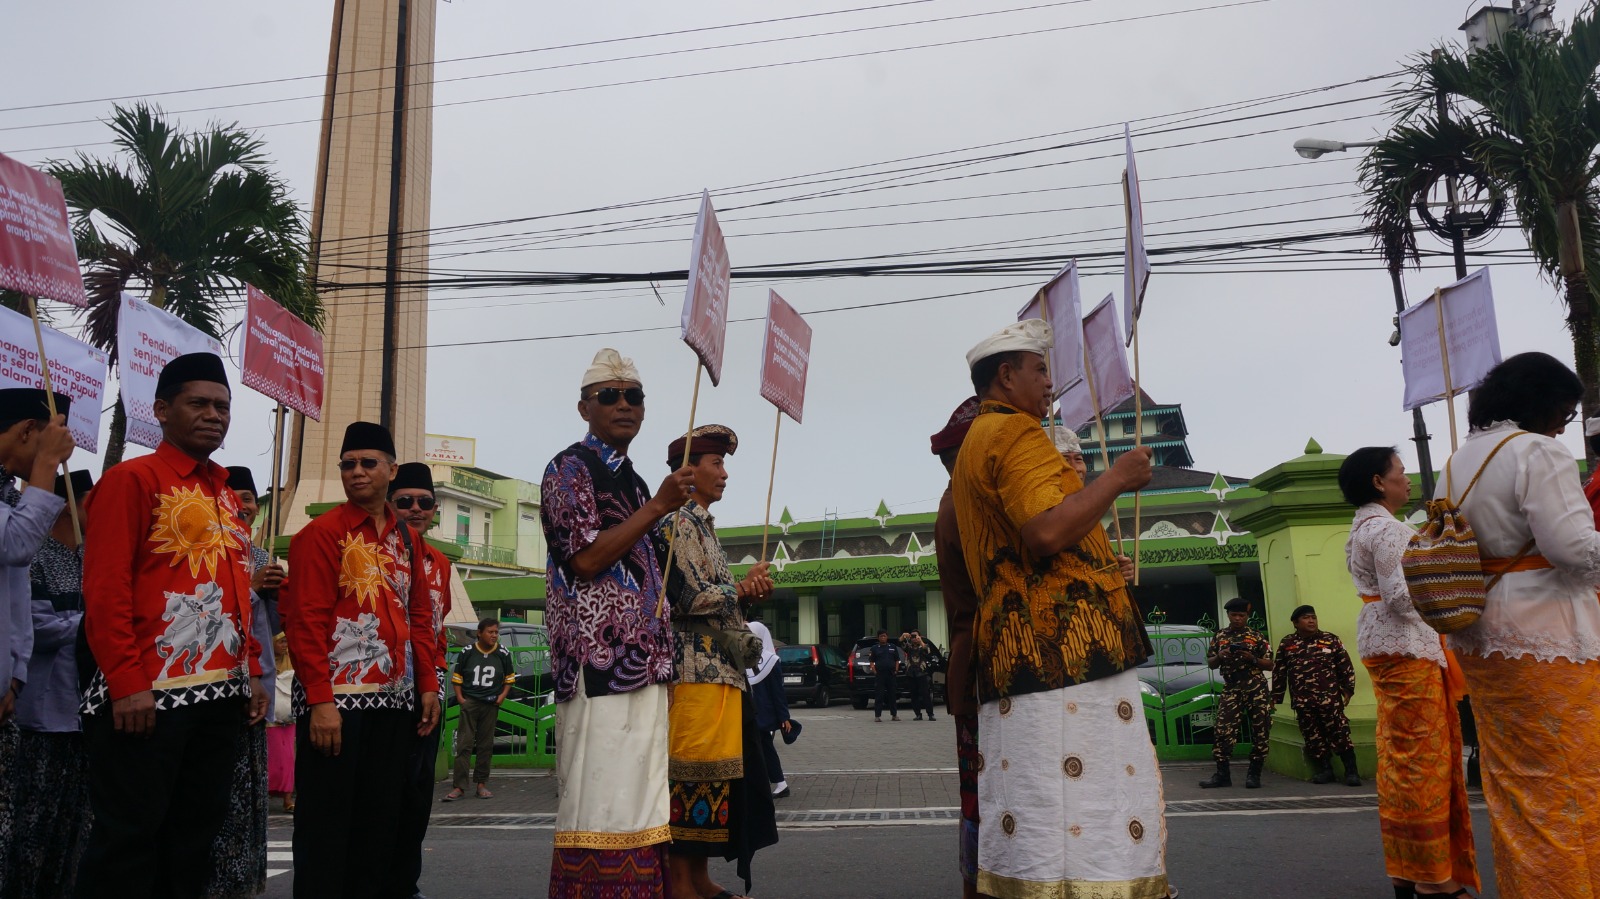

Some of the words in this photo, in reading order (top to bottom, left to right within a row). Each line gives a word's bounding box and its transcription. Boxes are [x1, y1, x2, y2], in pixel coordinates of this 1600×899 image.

[6, 223, 31, 242] orang
[133, 347, 167, 368] senjata
[279, 343, 294, 361] yang
[310, 362, 324, 376] kita
[296, 344, 320, 362] adalah
[129, 359, 155, 378] untuk
[10, 358, 44, 378] selalu
[48, 368, 69, 386] kita
[70, 381, 98, 401] pupuk
[472, 665, 495, 687] 12
